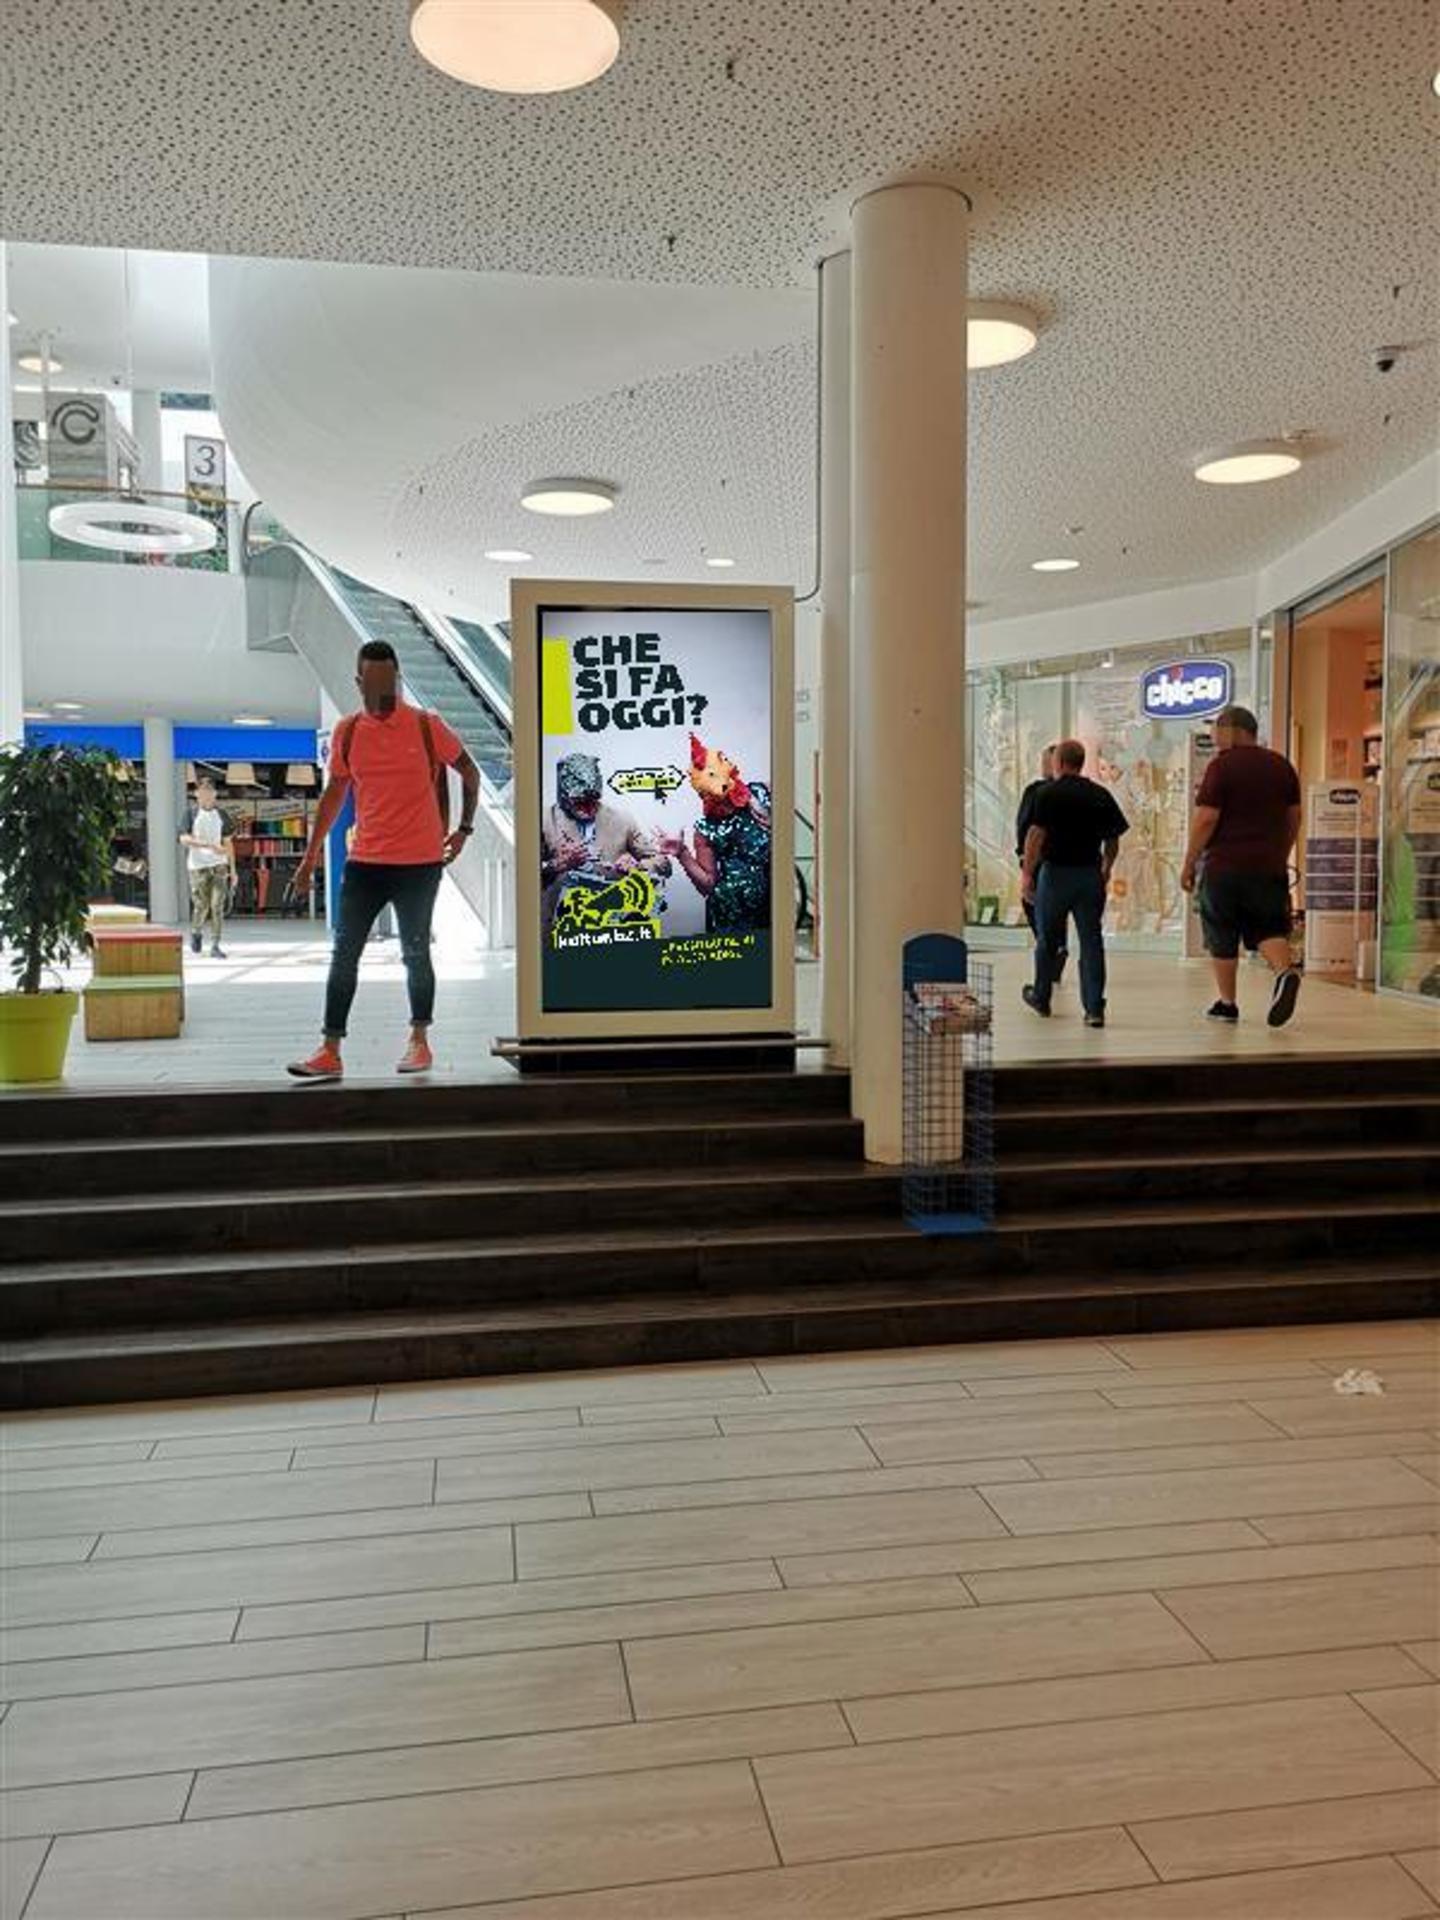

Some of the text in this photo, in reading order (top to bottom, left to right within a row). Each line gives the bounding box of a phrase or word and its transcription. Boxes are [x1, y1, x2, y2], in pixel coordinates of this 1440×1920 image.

[195, 446, 216, 476] 3
[573, 633, 660, 667] CHE
[576, 664, 685, 700] SI FA
[1147, 670, 1222, 706] chicco
[578, 693, 708, 732] OGGI?
